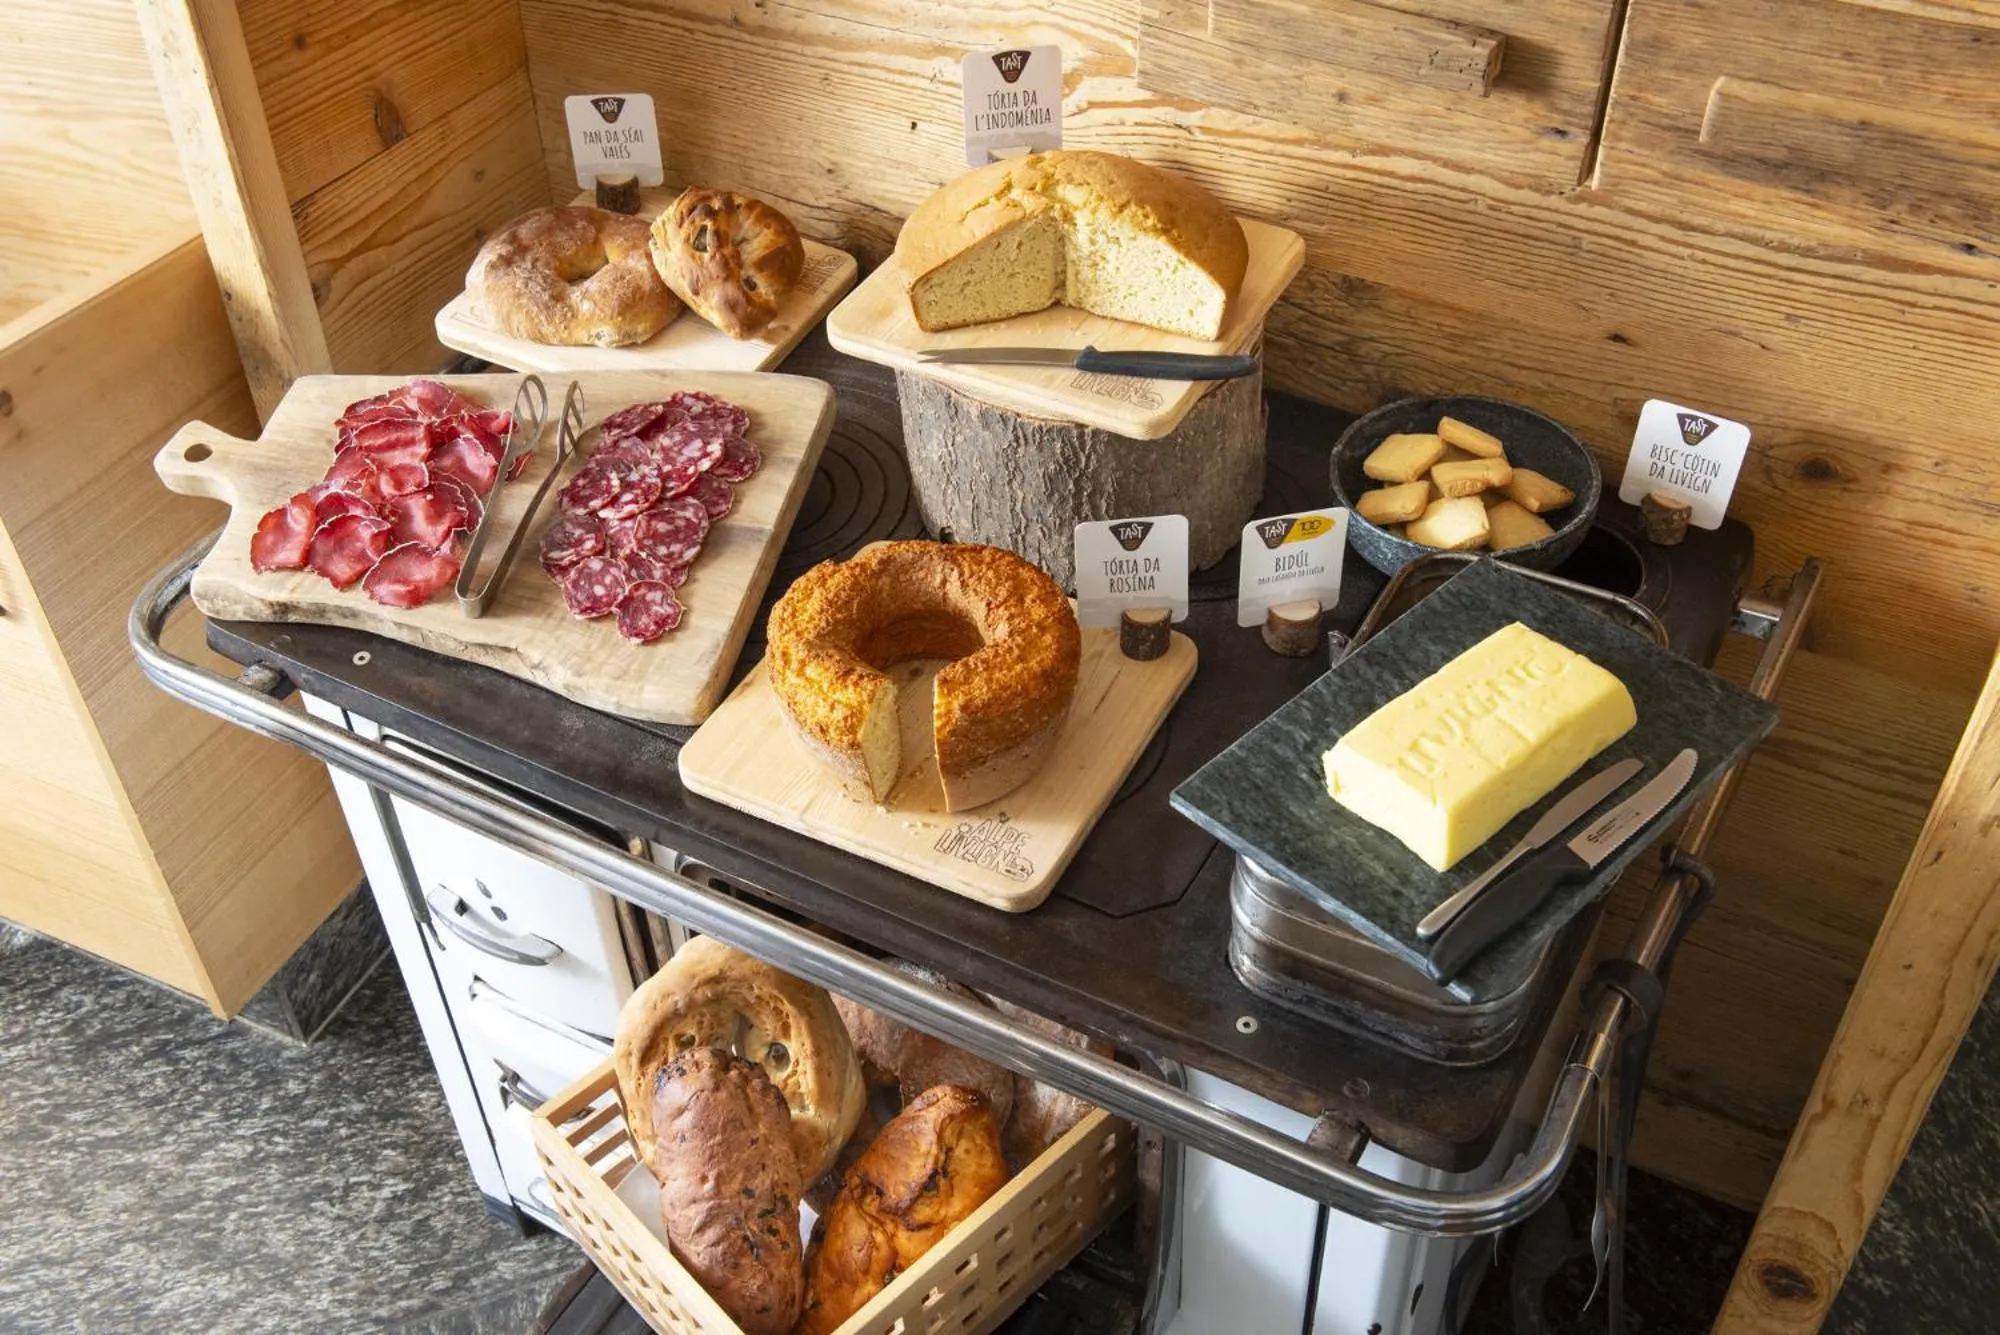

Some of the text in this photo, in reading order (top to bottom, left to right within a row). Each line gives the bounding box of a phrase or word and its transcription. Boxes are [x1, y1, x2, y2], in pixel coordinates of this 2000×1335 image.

[1000, 52, 1022, 71] TAST
[599, 98, 618, 113] TAST
[1023, 90, 1038, 107] DA
[583, 129, 602, 144] PAN
[605, 130, 620, 144] DA
[1684, 418, 1708, 436] TAST
[1648, 462, 1666, 480] DA
[1118, 522, 1144, 540] TAST
[1264, 519, 1288, 539] TAST
[1144, 557, 1161, 573] DA
